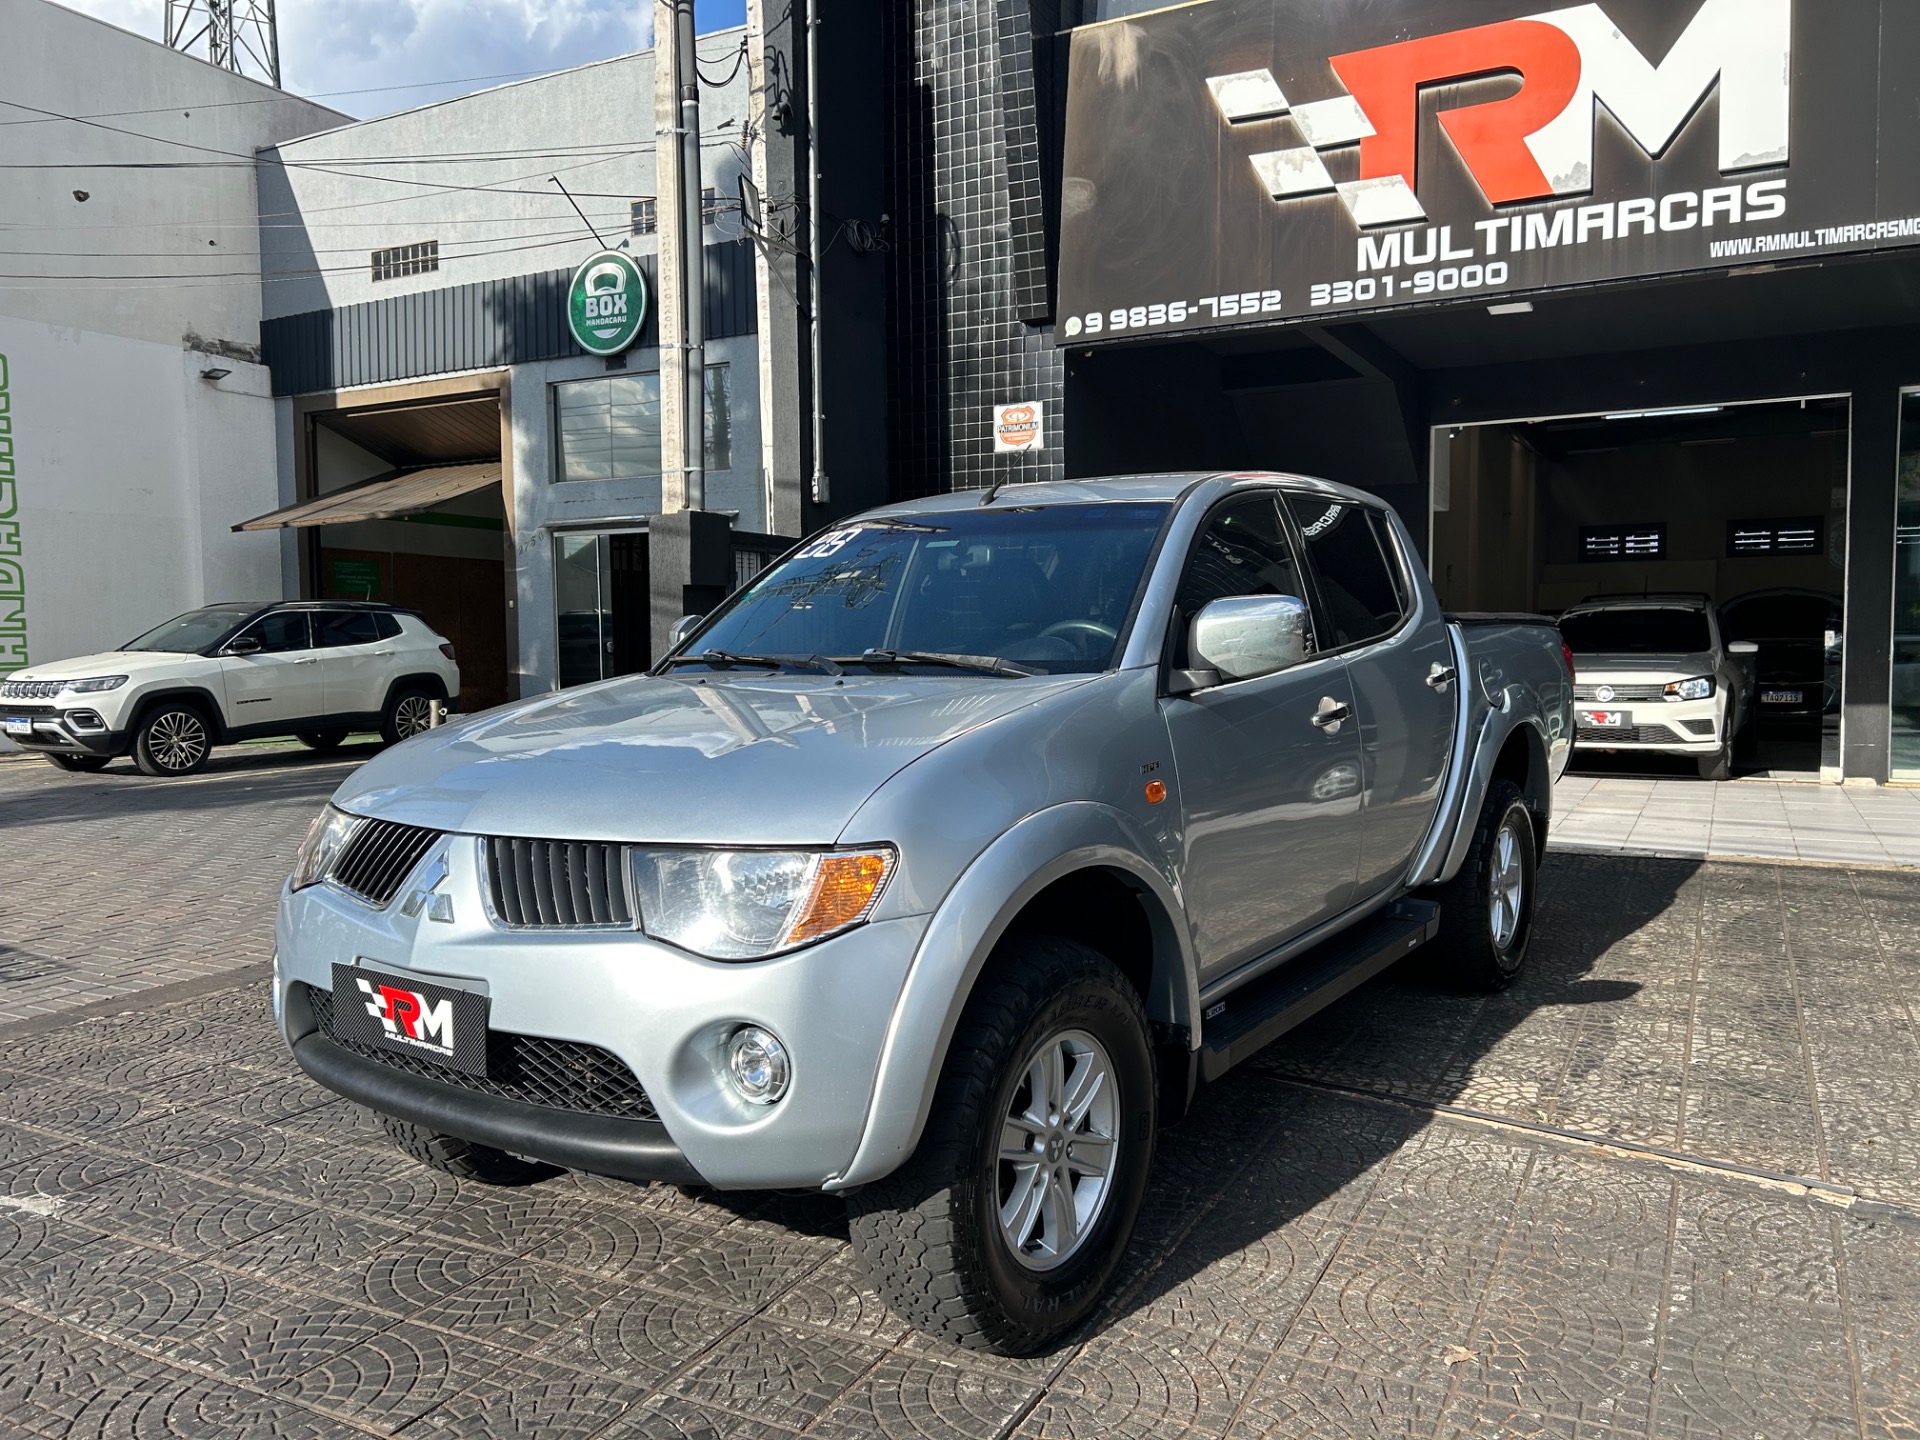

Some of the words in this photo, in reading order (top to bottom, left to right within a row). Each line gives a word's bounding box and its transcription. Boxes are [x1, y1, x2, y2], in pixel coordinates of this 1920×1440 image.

[1328, 0, 1790, 204] RM
[1356, 178, 1787, 272] MULTIMARCAS
[585, 293, 627, 318] BOX
[1310, 261, 1508, 307] 3301-9000
[585, 315, 627, 327] MANDACARU
[1085, 312, 1103, 334] 9
[1109, 289, 1282, 331] 9836-7552
[378, 984, 453, 1049] RM
[1207, 1003, 1225, 1018] L200
[385, 1031, 454, 1057] MULTIMARCAS
